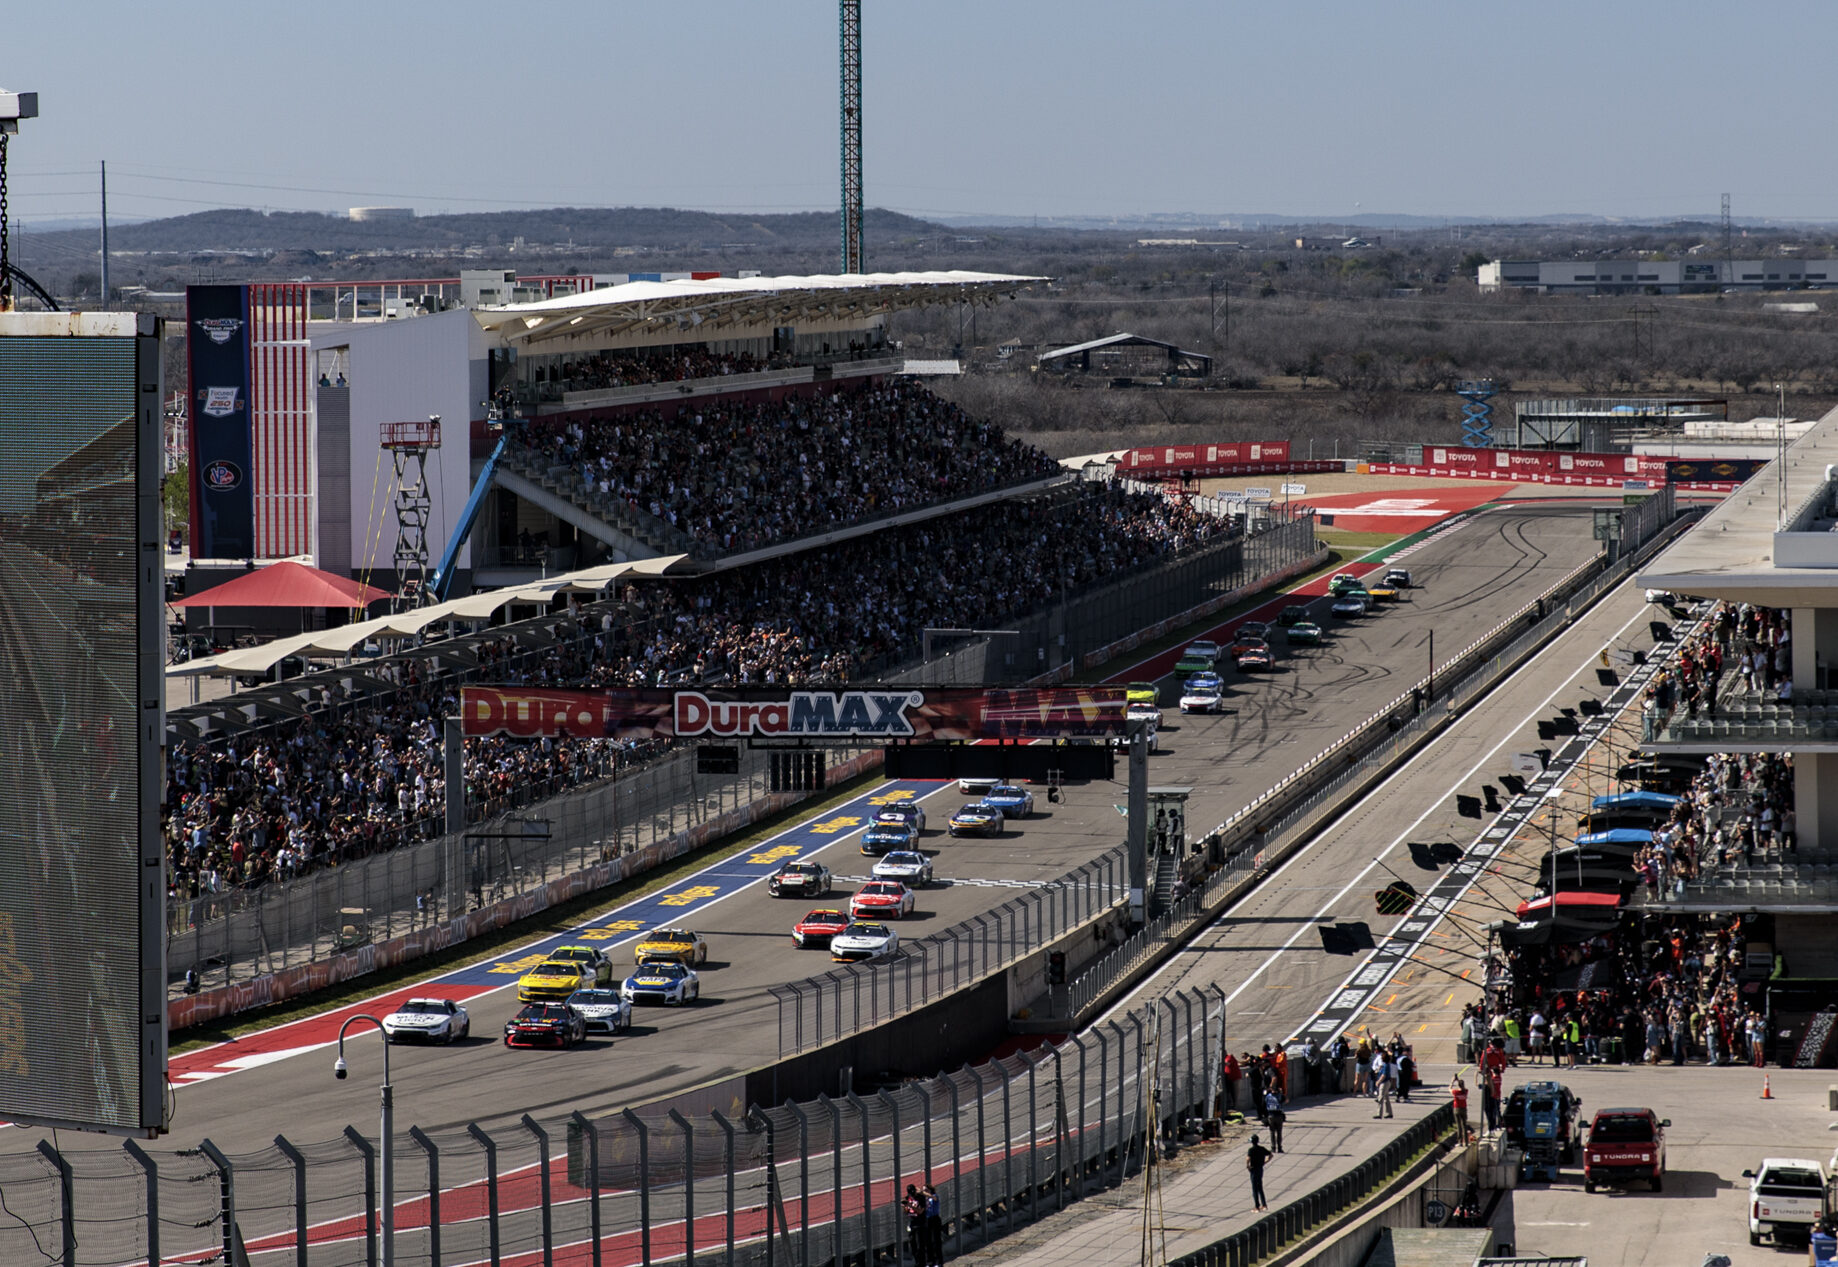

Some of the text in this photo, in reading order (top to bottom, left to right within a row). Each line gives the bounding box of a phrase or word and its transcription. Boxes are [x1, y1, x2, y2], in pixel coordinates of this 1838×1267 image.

[1262, 448, 1283, 456] TOYOTA
[1448, 453, 1477, 462] TOYOTA
[1510, 456, 1540, 465] TOYOTA
[1575, 459, 1605, 468] TOYOTA
[211, 467, 228, 483] VP
